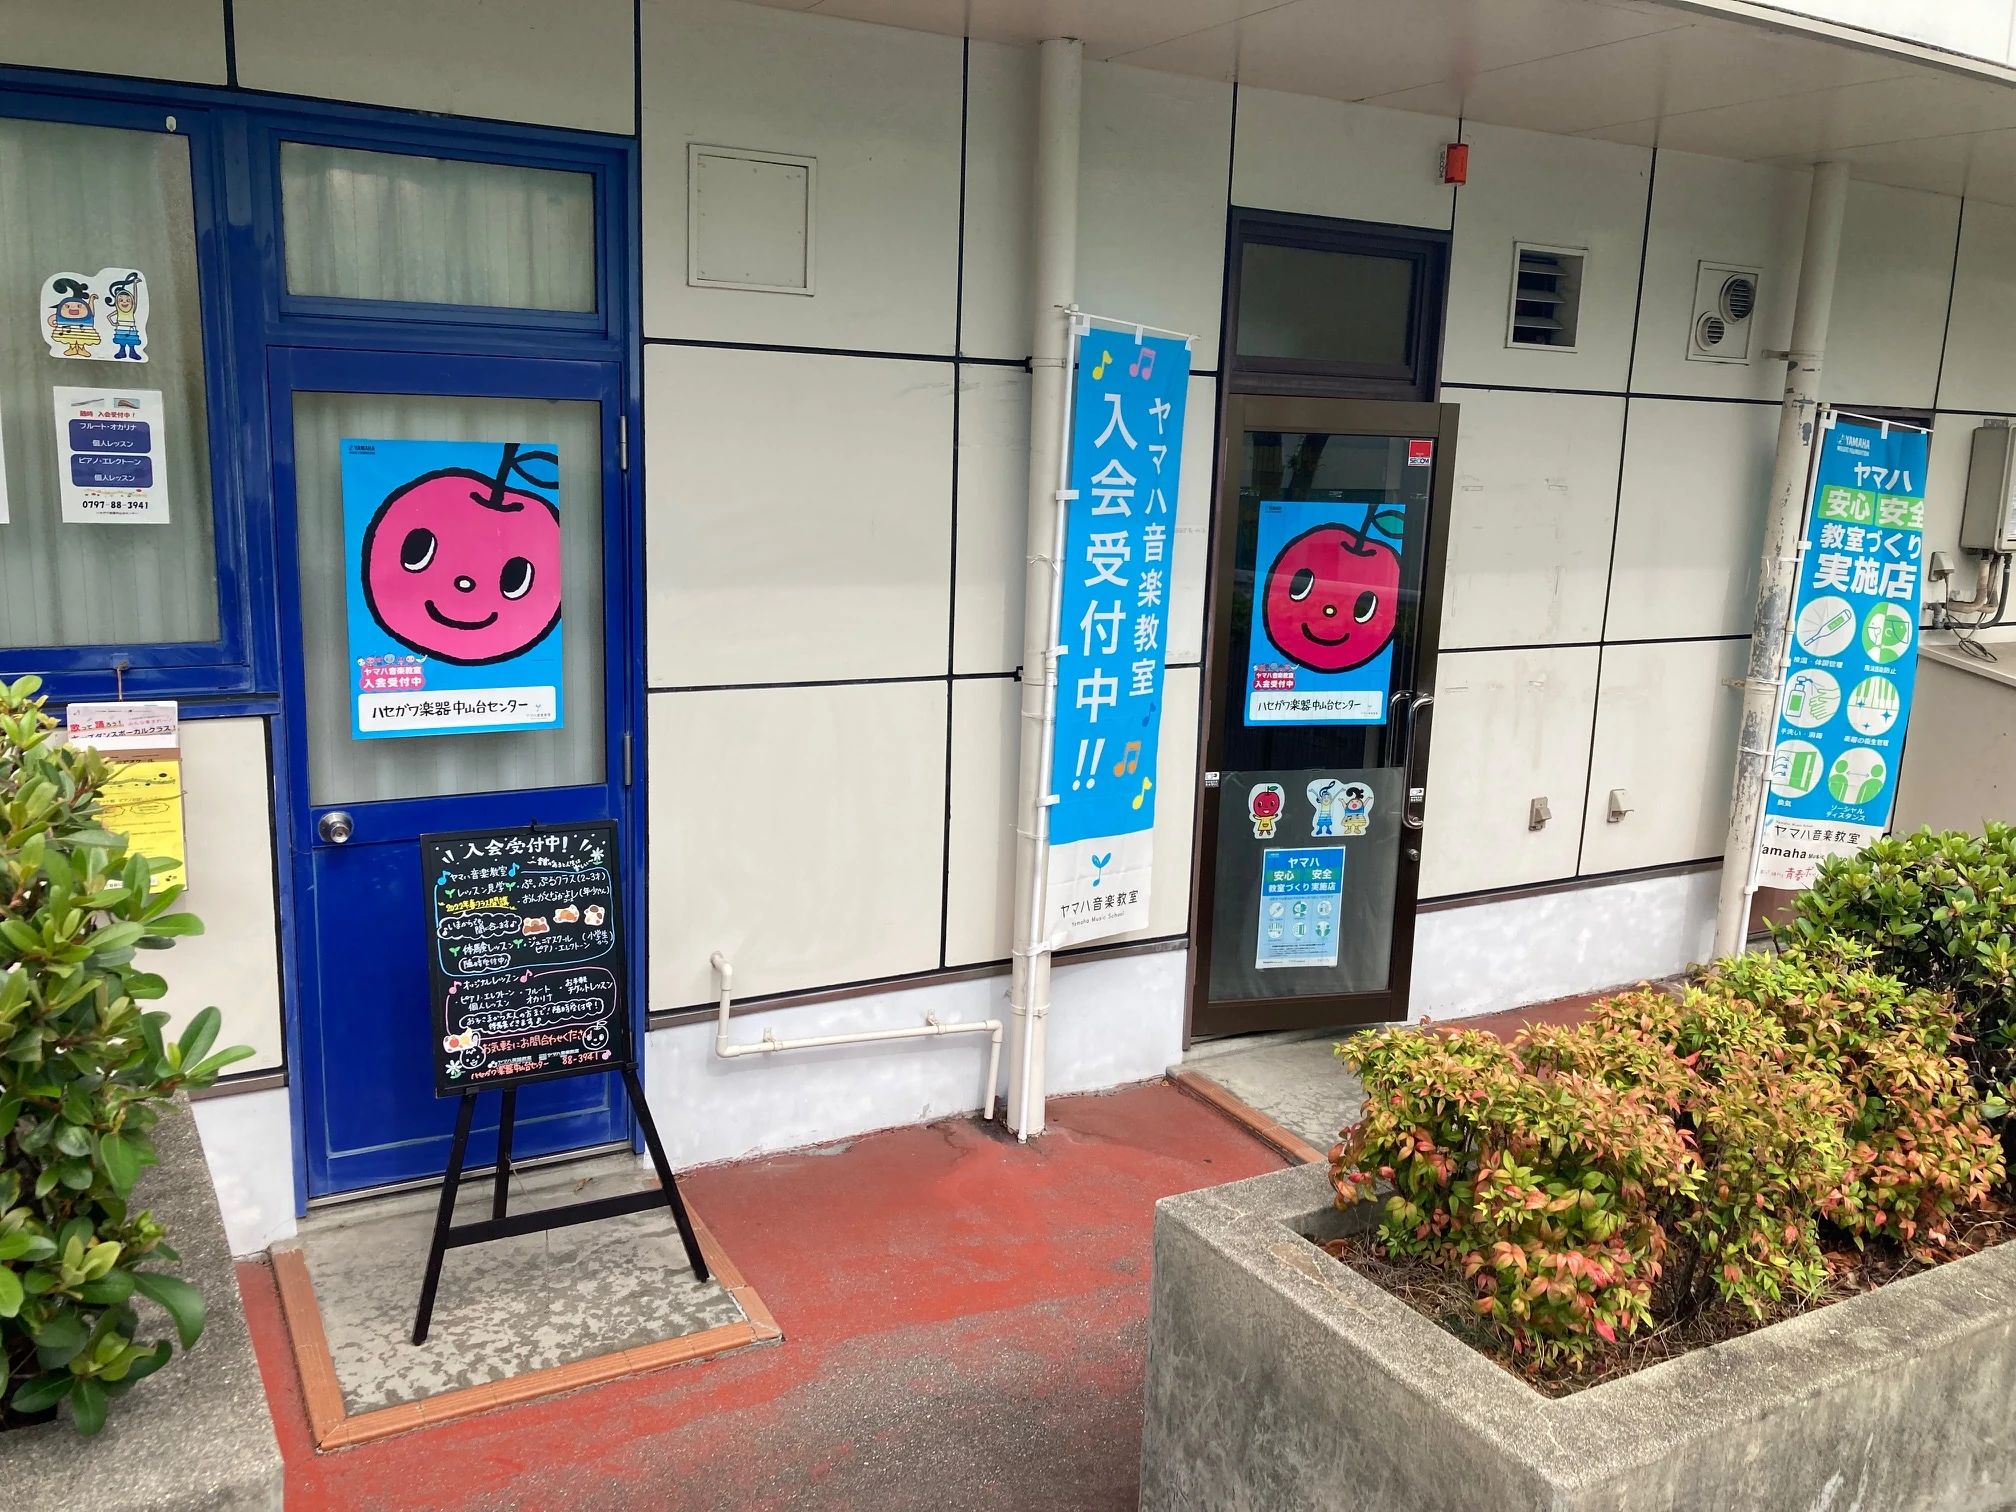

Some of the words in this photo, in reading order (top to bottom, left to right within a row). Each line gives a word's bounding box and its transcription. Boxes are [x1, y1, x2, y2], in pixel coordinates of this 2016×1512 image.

[80, 422, 136, 431] フルート・オカリナ
[92, 439, 133, 448] 個人レッスン
[1845, 434, 1871, 450] YAMAHA
[79, 457, 141, 466] ピアノ・エレクトーン
[94, 473, 135, 482] 個人レッスン
[1854, 462, 1912, 492] ヤマハ
[82, 501, 148, 509] 0797-88-3941
[1826, 489, 1870, 520] 安心
[1820, 522, 1921, 559] 教室づくり
[1128, 398, 1171, 696] ヤマハ音楽教室
[1813, 552, 1917, 600] 実施店
[364, 666, 421, 675] ヤマハ音楽教室
[364, 677, 422, 688] 入会受付中
[1255, 680, 1294, 689] 入会受付中
[1831, 804, 1864, 815] ソーシャル
[1826, 811, 1866, 822] ディスタンス
[1775, 825, 1860, 845] ヤマハ音楽教室
[463, 836, 568, 860] 入会受付中!
[1761, 843, 1807, 859] amaha
[1288, 857, 1320, 868] ヤマハ
[1273, 871, 1295, 881] 安心
[1311, 869, 1332, 880] 安全
[457, 882, 506, 898] レッスン見学
[1061, 890, 1139, 918] ヤマハ音楽教室
[525, 985, 550, 996] フルート
[468, 1000, 510, 1012] 個人レッスン
